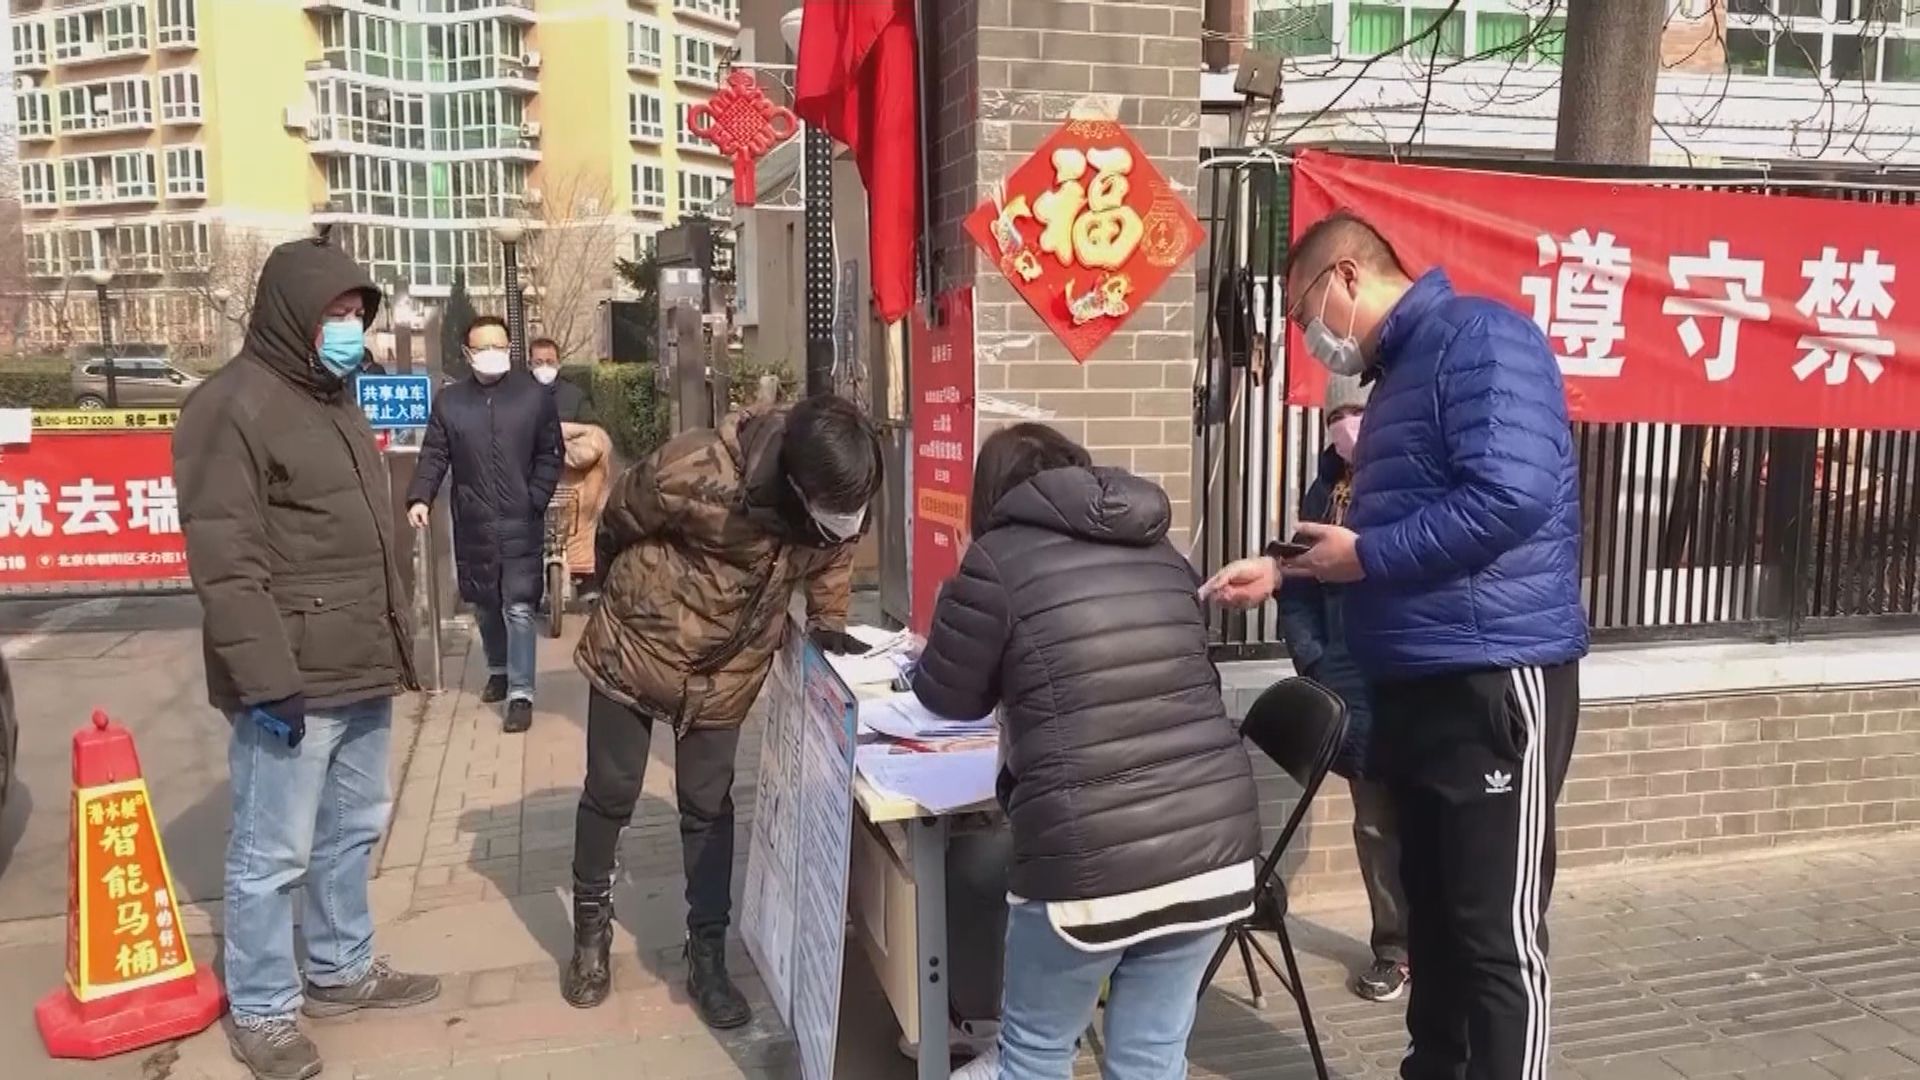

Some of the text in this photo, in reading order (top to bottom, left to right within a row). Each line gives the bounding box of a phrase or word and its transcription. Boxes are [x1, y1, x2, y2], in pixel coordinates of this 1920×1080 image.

[1032, 147, 1144, 271] 福
[1520, 228, 1897, 386] 遵守禁
[362, 384, 425, 401] 共享单车
[363, 403, 426, 421] 禁止入院
[0, 476, 182, 538] 就去瑞
[99, 822, 158, 978] 智能马桶
